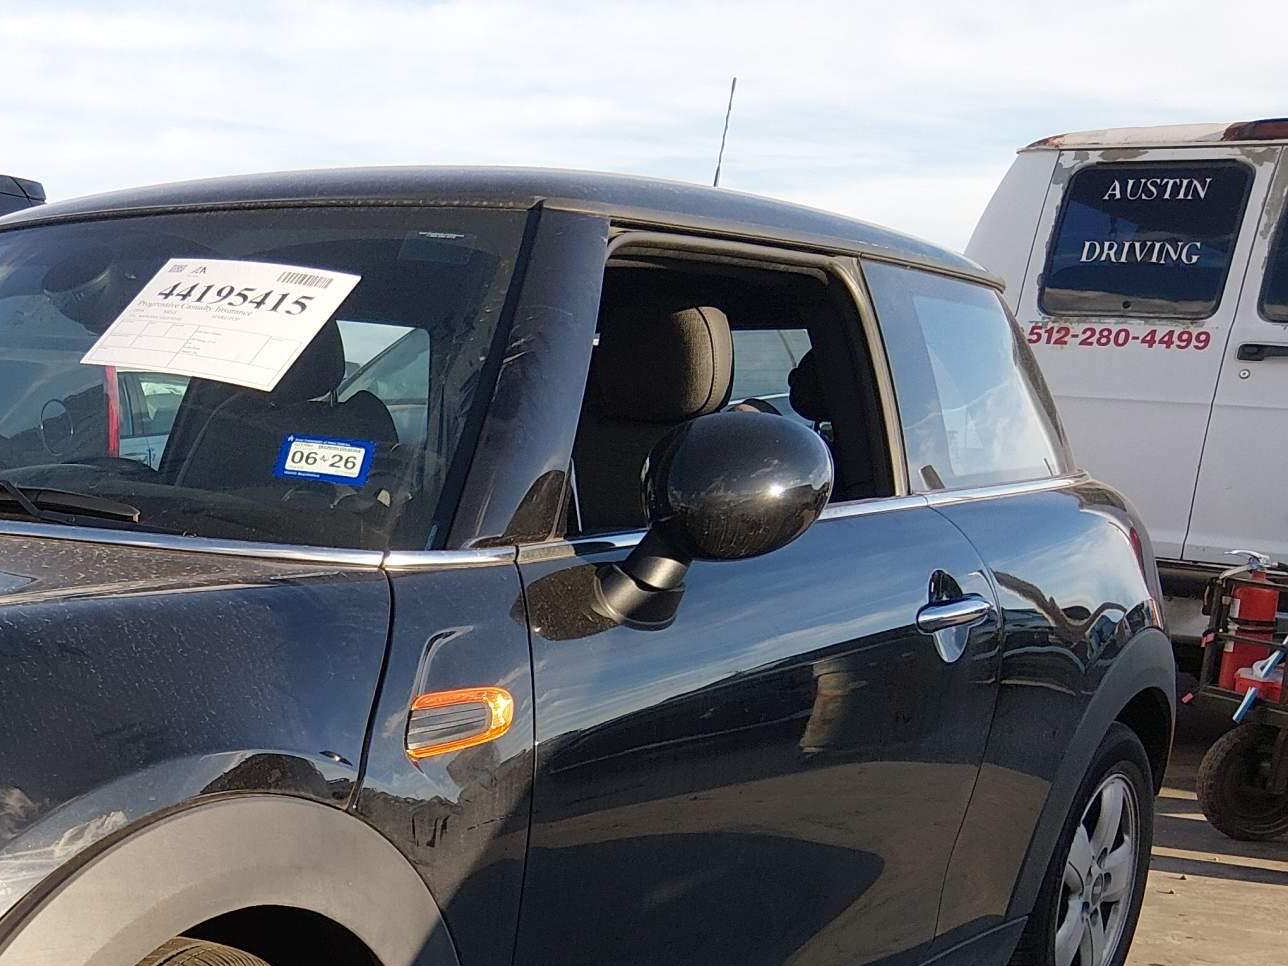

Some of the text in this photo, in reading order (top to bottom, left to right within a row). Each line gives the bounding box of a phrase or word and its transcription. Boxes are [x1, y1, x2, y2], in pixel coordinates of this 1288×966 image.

[1103, 178, 1213, 201] AUSTIN
[1079, 240, 1201, 265] DRIVING
[137, 299, 180, 309] Progressive
[181, 303, 212, 312] Casualty
[215, 306, 253, 316] Insurance
[158, 281, 316, 316] 44195415
[1027, 325, 1212, 351] 512-280-4499
[291, 450, 358, 470] 06 26
